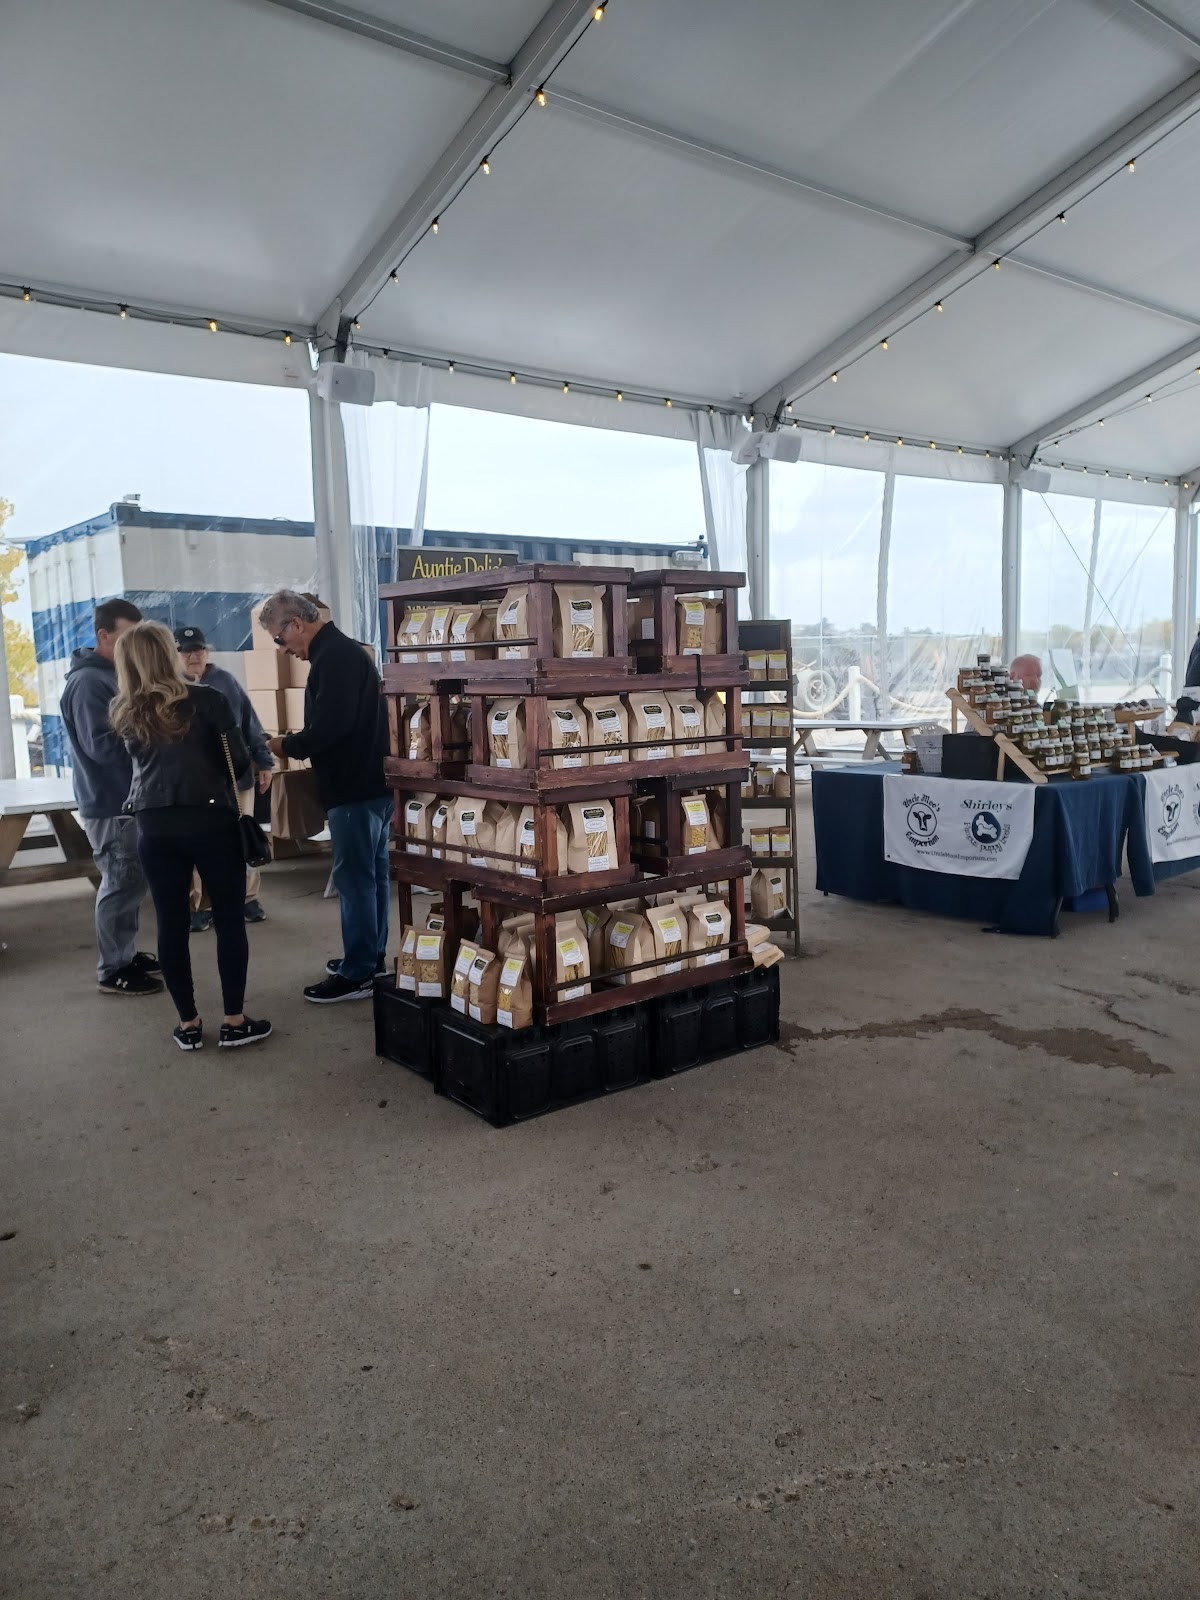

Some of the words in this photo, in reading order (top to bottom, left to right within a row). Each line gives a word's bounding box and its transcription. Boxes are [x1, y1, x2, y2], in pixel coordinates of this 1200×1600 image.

[412, 554, 461, 578] Auntie
[902, 793, 920, 809] Uncle
[960, 798, 1013, 813] Shirley's
[905, 830, 940, 847] Emporium
